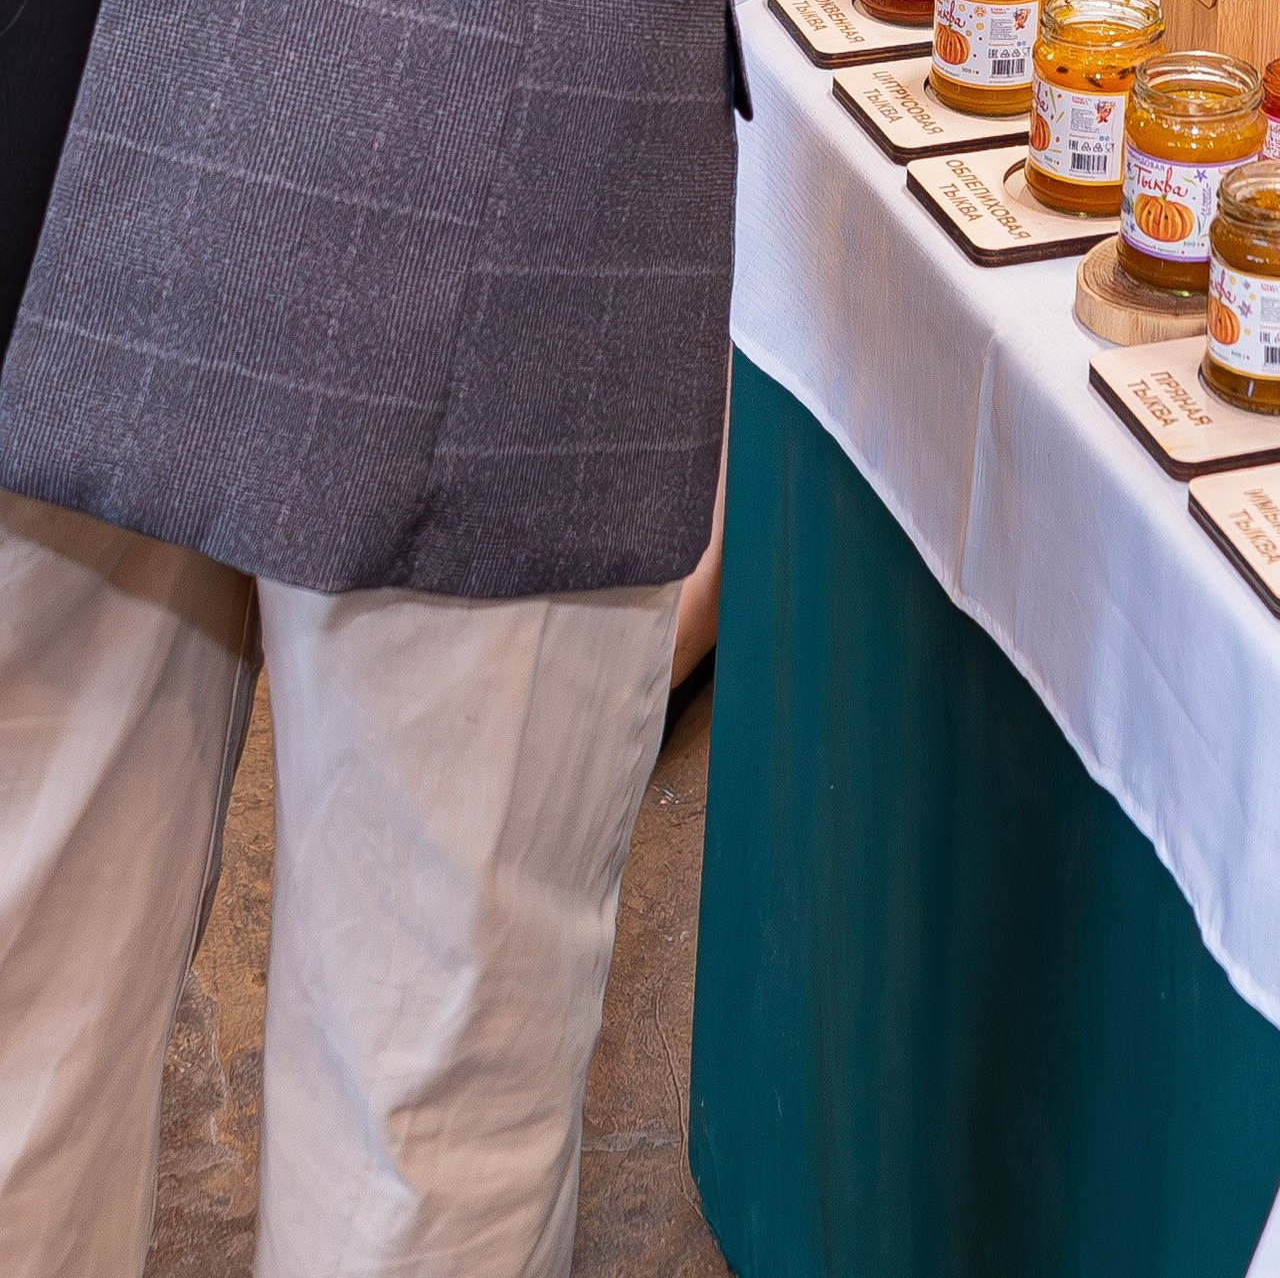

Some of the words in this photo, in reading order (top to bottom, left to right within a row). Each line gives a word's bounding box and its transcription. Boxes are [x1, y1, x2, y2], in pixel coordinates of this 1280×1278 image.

[792, 0, 828, 32] ТЫКВА
[862, 88, 905, 124] ТЫКВА
[872, 70, 945, 136] ЦИТРУСОВАЯ
[939, 183, 983, 222] ТЫКВА
[945, 159, 1032, 241] ОБЛЕПИХОВАЯ
[1134, 165, 1188, 197] Тыква
[1126, 379, 1179, 427] ТЫКВА
[1150, 371, 1214, 427] ПРЯНАЯ
